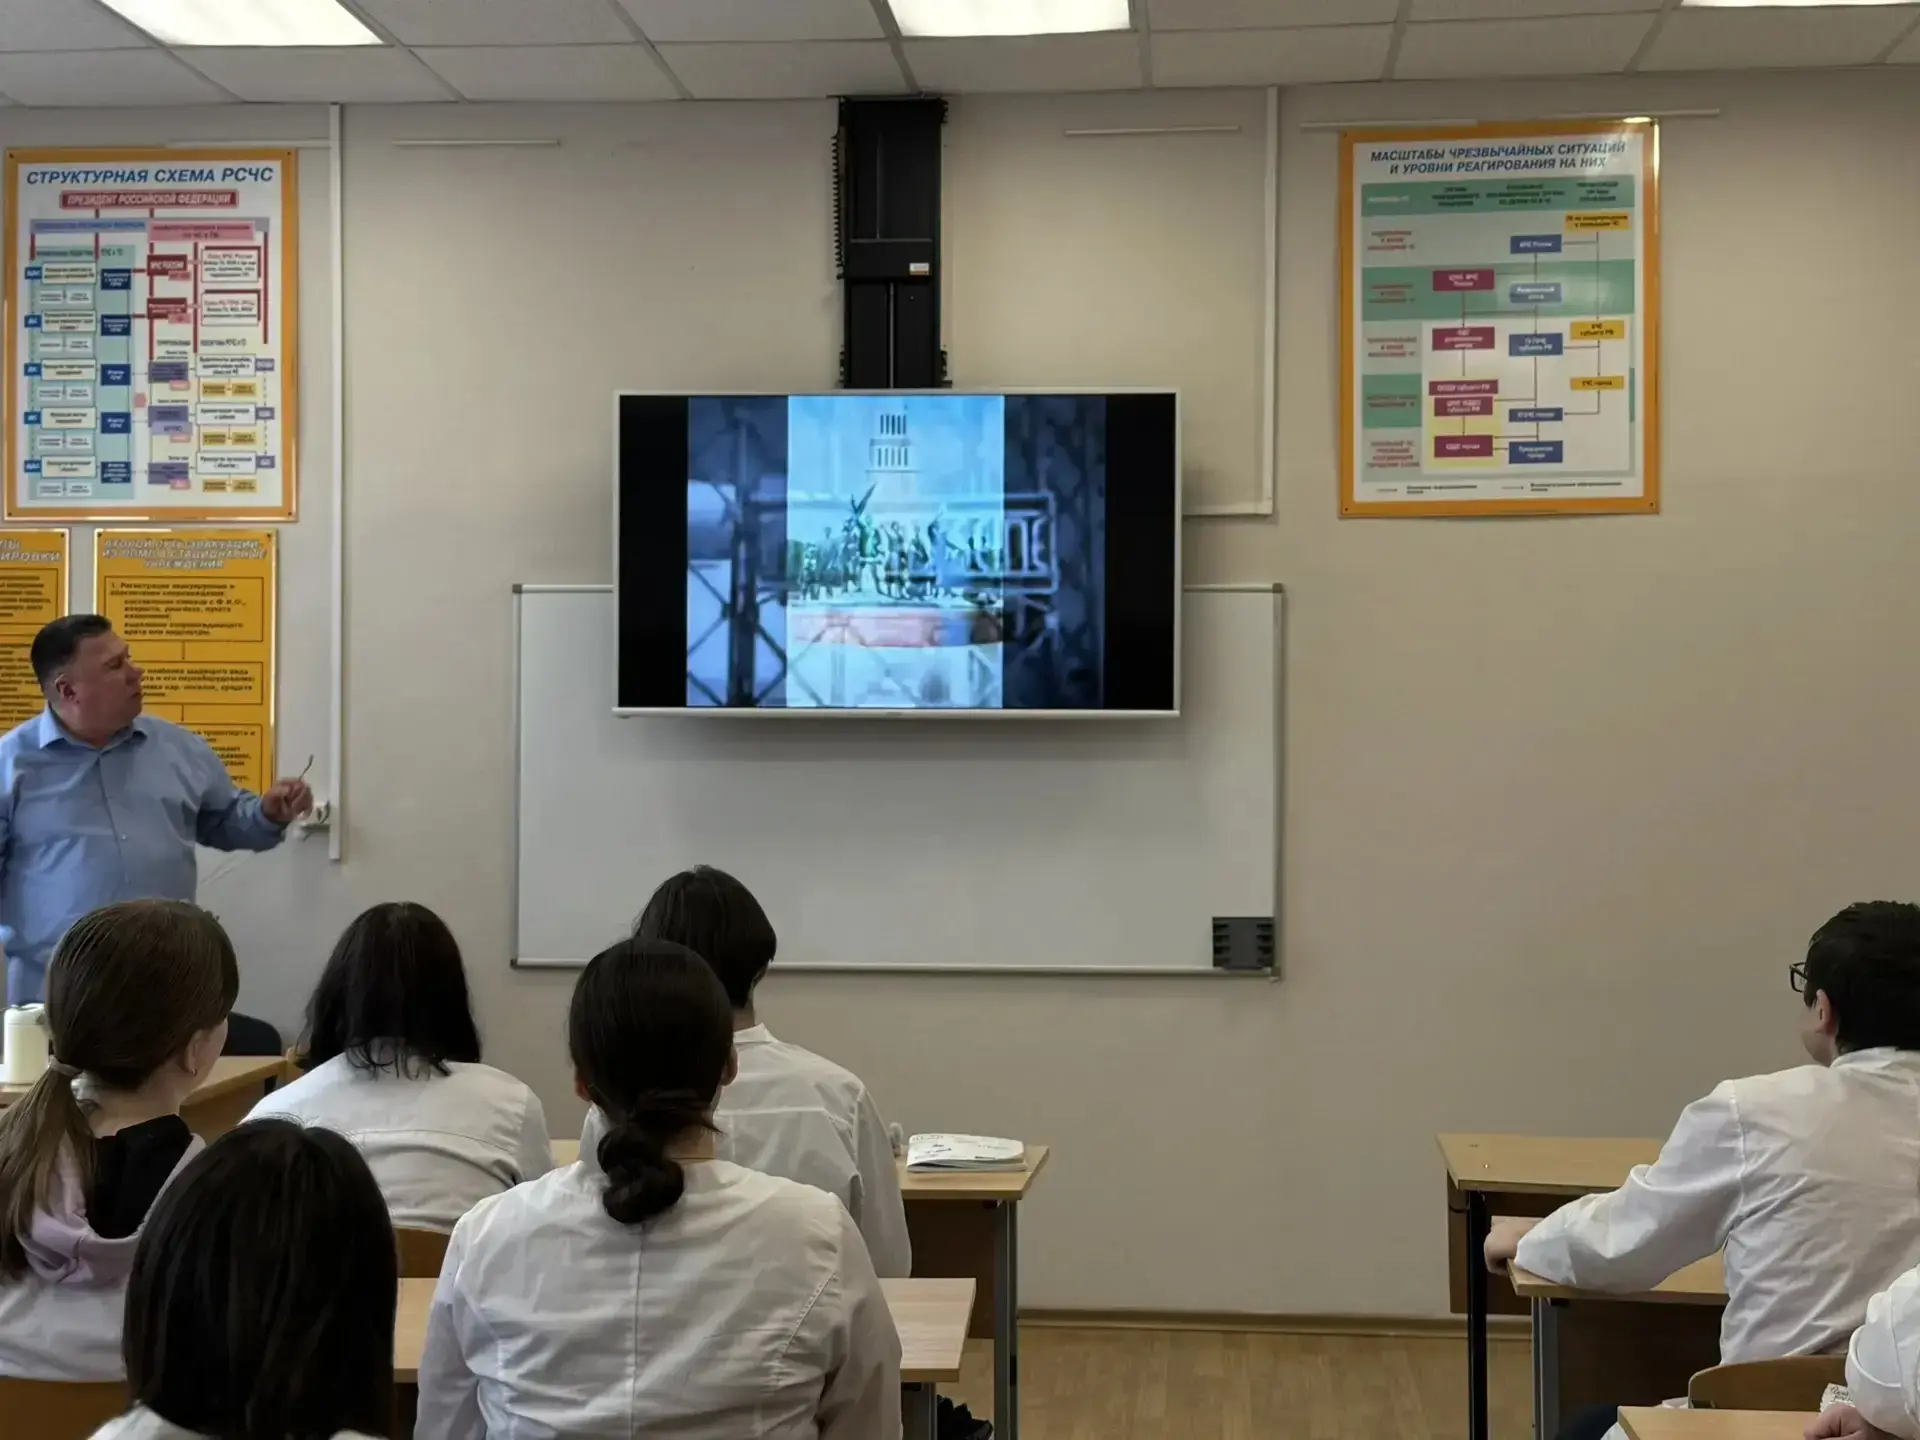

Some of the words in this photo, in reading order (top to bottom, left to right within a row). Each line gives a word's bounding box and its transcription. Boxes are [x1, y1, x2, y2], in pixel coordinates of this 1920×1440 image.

[1370, 149, 1445, 163] МАСШТАБЫ
[1448, 144, 1553, 160] ЧРЕЗВЫЧАЙНЫХ
[1557, 141, 1626, 156] СИТУАЦИЙ
[1389, 164, 1399, 175] И
[1402, 162, 1453, 175] УРОВНИ
[1456, 158, 1556, 173] РЕАГИРОВАНИЯ
[1559, 157, 1577, 169] НА
[1579, 156, 1606, 169] НИХ
[27, 169, 149, 185] СТРУКТУРНАЯ
[154, 168, 215, 183] СХЕМА
[221, 167, 274, 182] РСЧС
